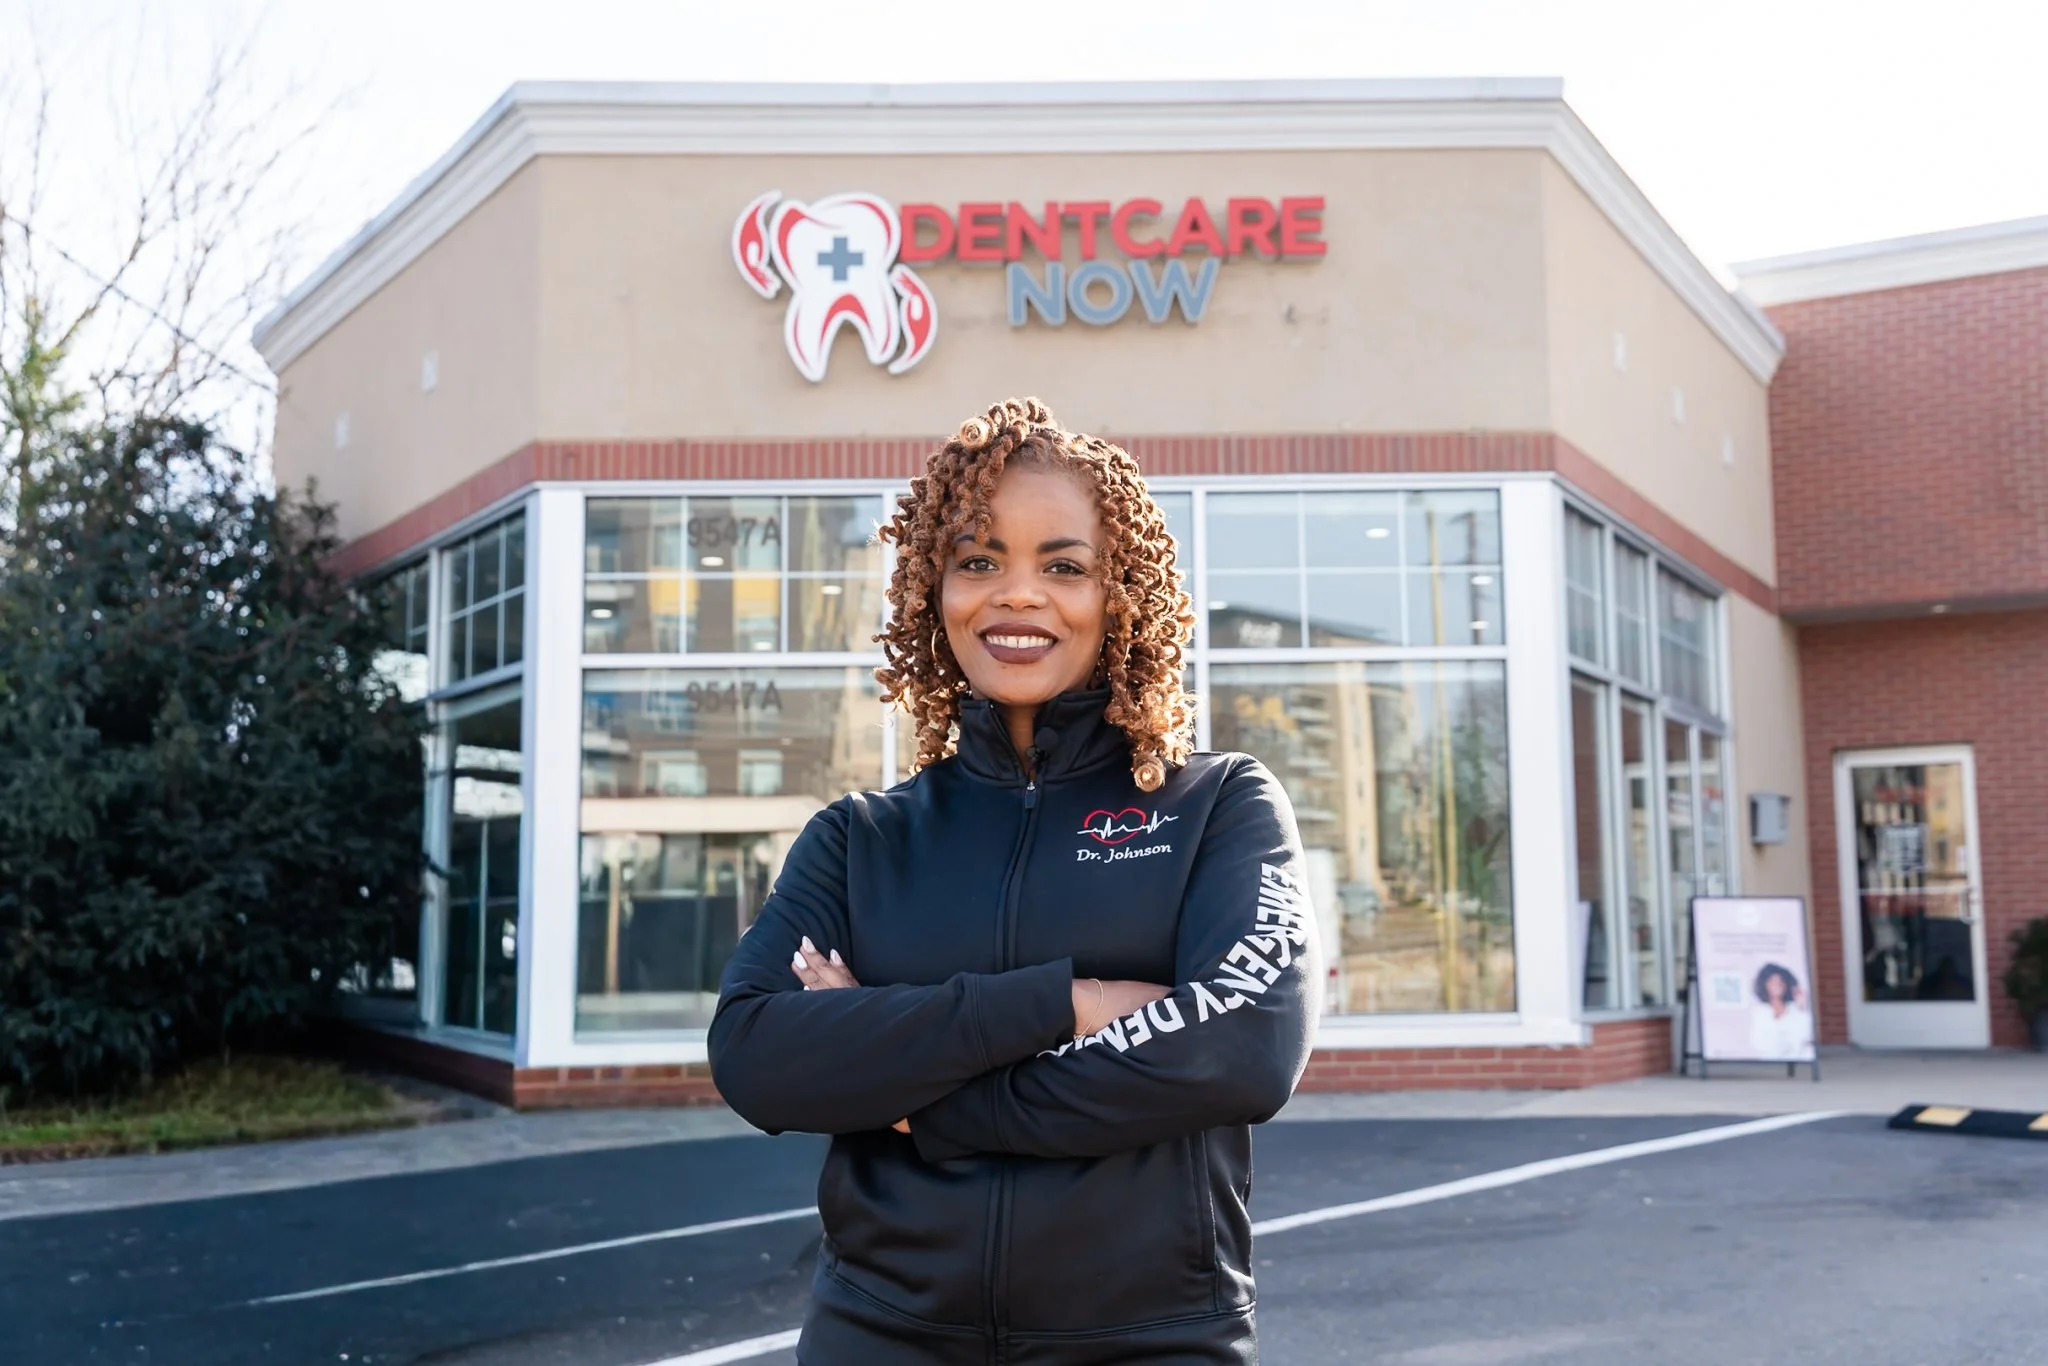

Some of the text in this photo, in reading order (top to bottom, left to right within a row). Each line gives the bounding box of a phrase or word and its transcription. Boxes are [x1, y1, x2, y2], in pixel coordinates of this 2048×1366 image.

[899, 196, 1327, 263] DENTCARE
[1006, 257, 1221, 327] NOW
[686, 517, 781, 548] 9547A
[1076, 843, 1173, 864] Dr. Johnson
